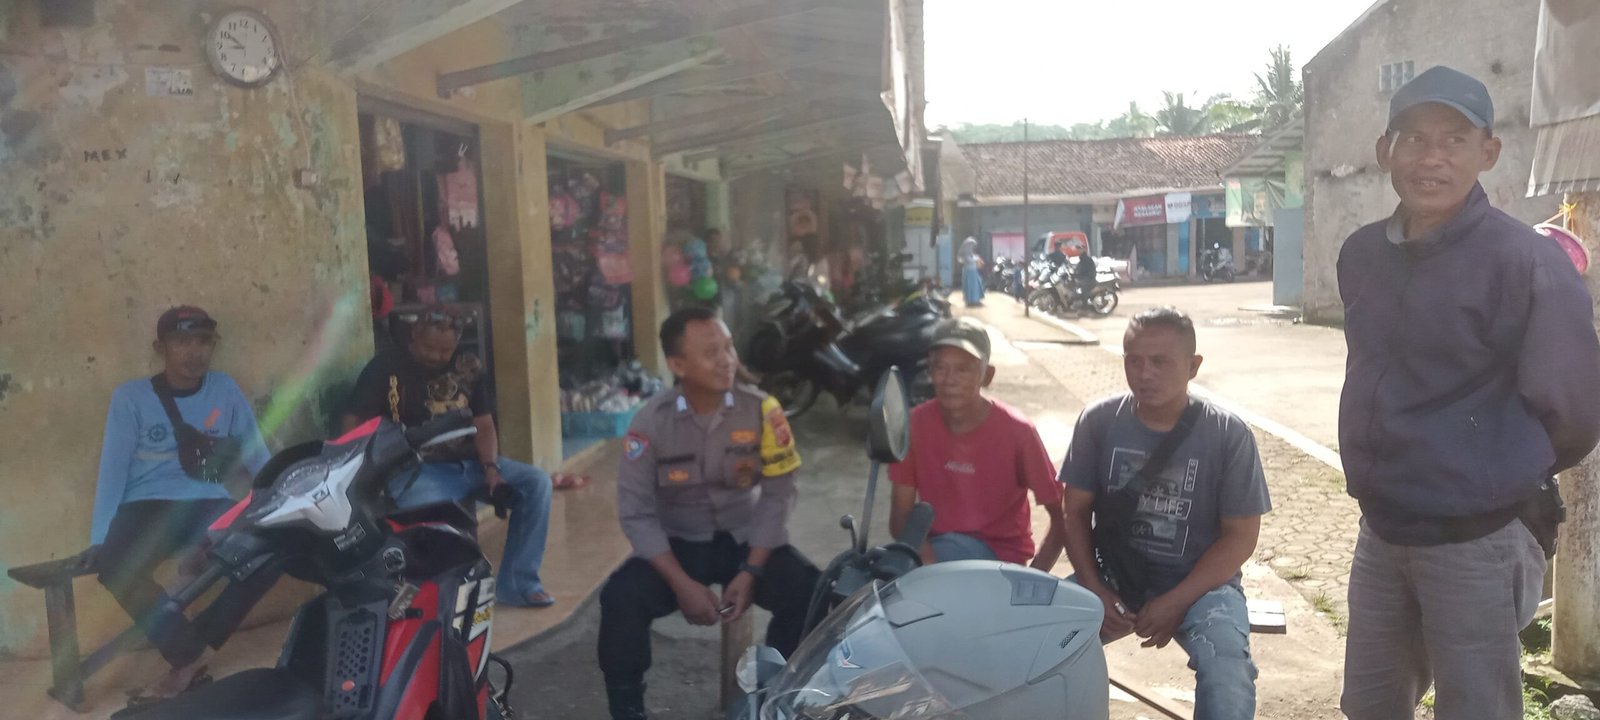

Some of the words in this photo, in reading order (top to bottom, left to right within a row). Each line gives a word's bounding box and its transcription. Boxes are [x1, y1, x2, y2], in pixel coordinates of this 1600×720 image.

[228, 22, 237, 31] 11
[239, 19, 249, 29] 12
[220, 31, 230, 39] 10
[217, 41, 223, 50] 9
[220, 52, 227, 61] 8
[231, 63, 236, 72] 7
[1155, 496, 1184, 516] LIFE
